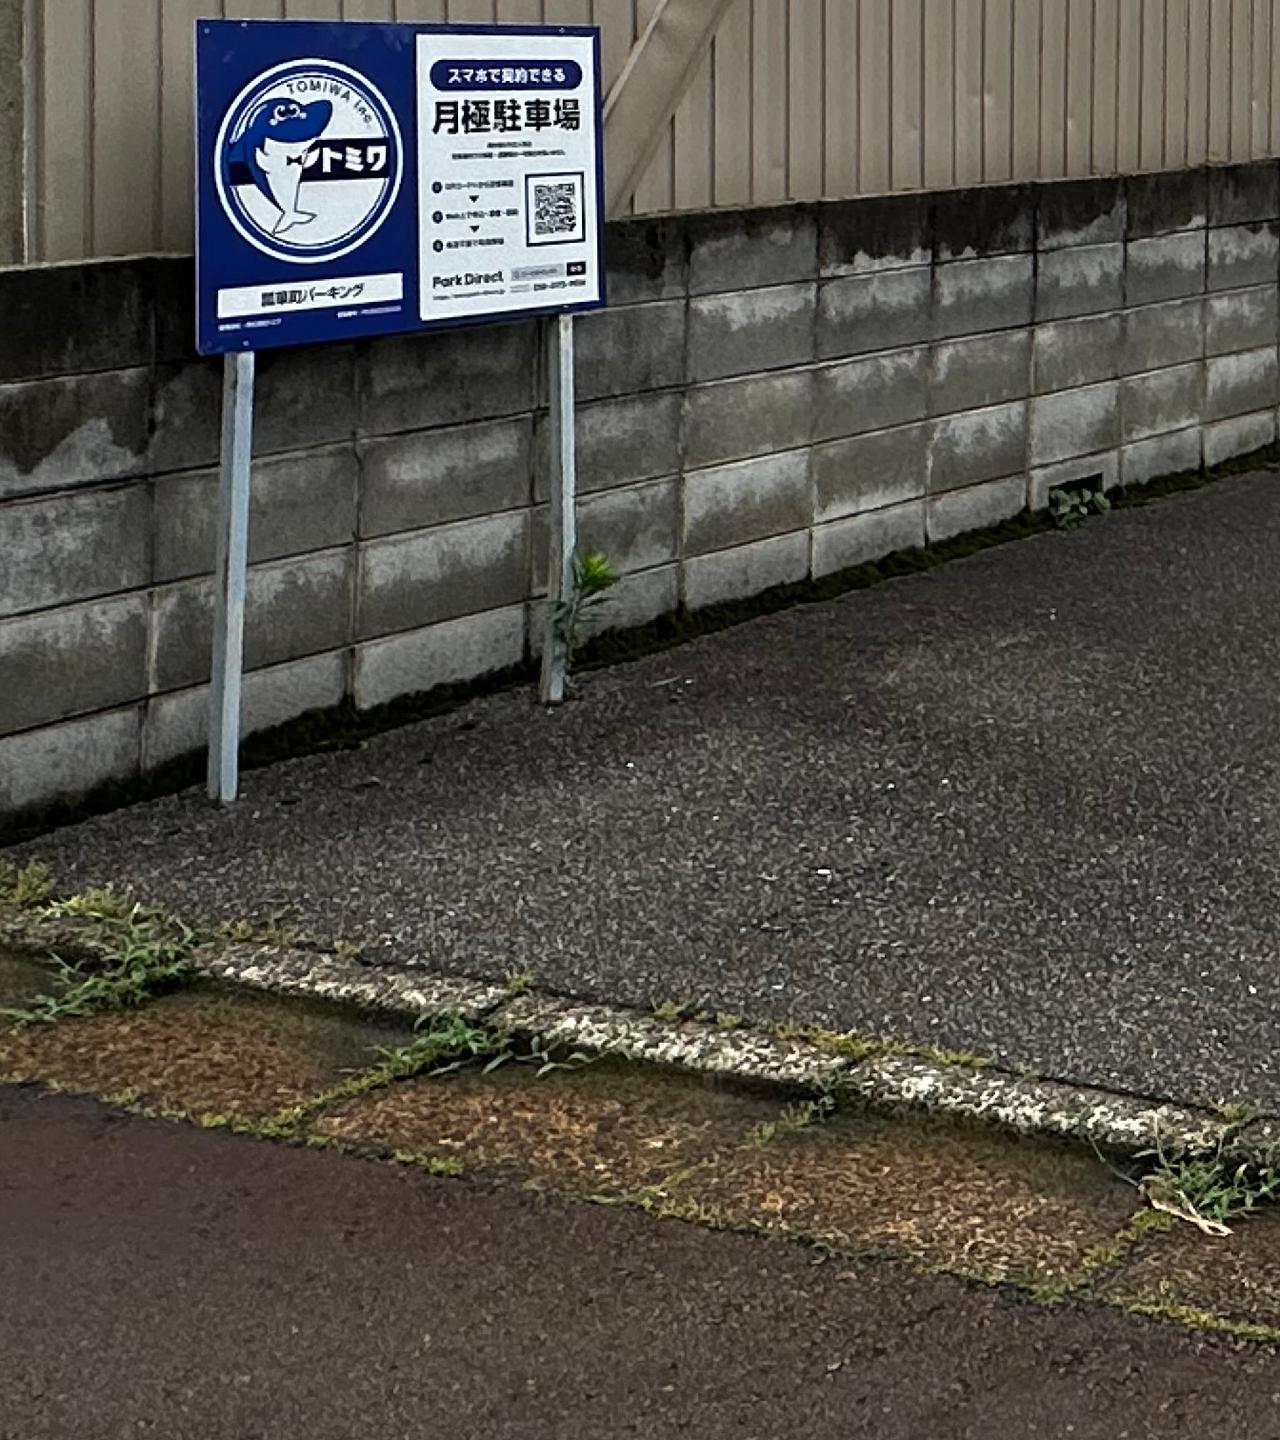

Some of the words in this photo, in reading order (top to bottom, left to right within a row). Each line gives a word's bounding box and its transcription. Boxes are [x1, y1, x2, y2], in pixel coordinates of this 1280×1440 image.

[448, 67, 566, 84] スマホで契約できる
[286, 78, 352, 102] TOMIWA
[432, 98, 581, 134] 月極駐車場
[322, 145, 387, 173] トミワ
[432, 274, 463, 289] Park
[464, 270, 505, 286] Direct
